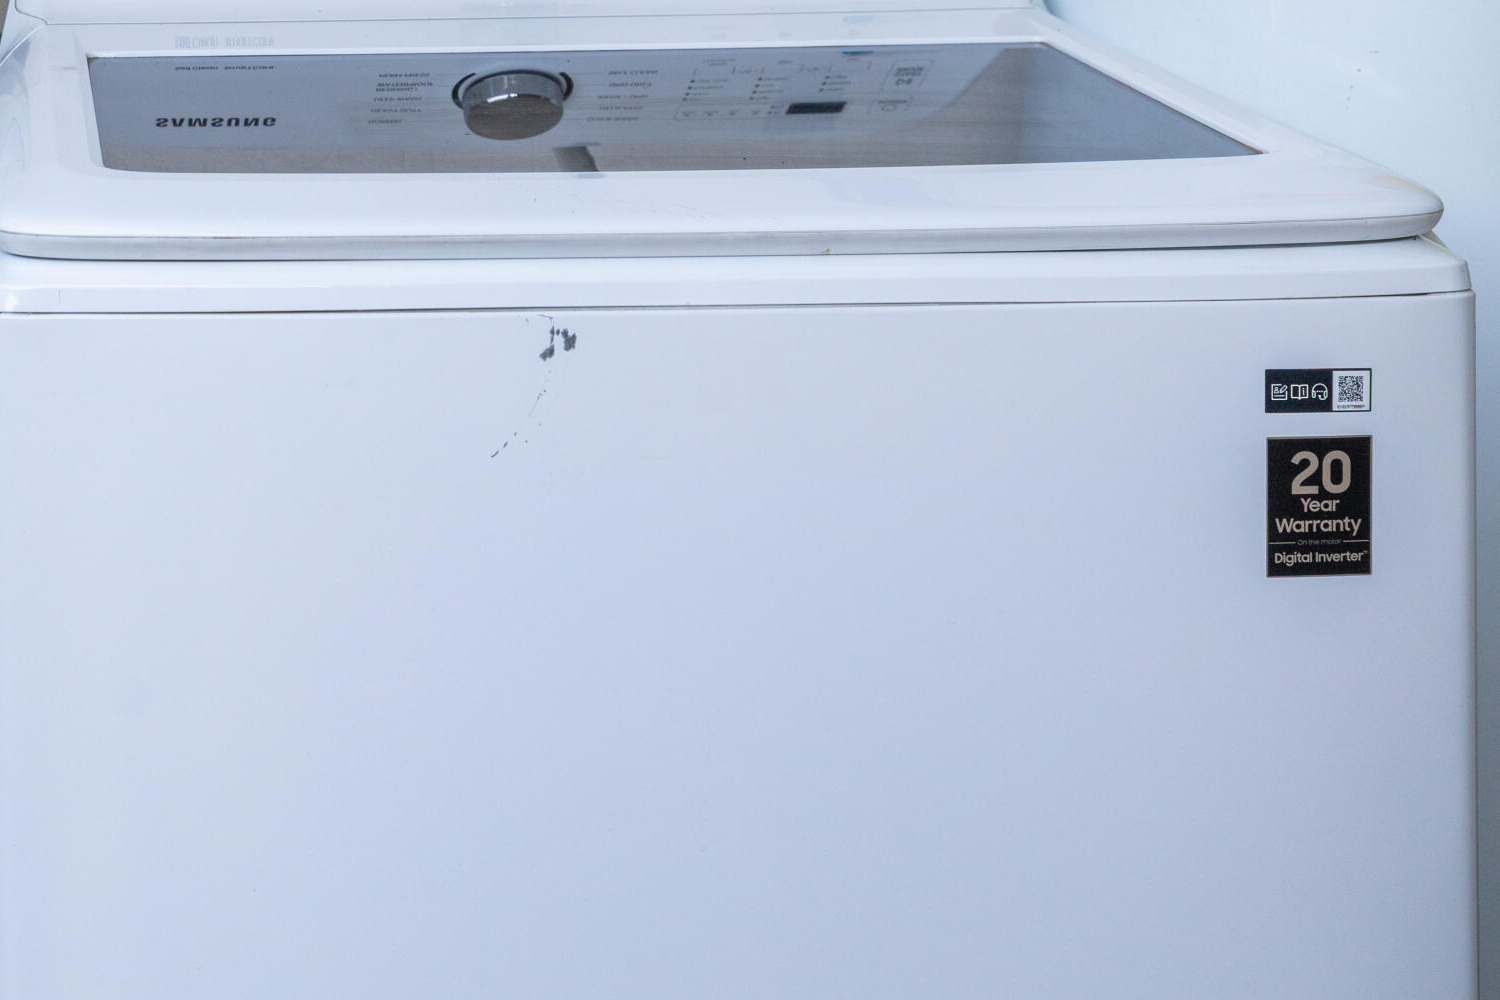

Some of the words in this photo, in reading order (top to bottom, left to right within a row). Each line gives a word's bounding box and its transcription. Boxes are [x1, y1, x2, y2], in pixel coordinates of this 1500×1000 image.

[1290, 450, 1352, 496] 20
[1300, 497, 1340, 513] Year
[1275, 517, 1362, 536] Warranty
[1274, 551, 1313, 567] Digital
